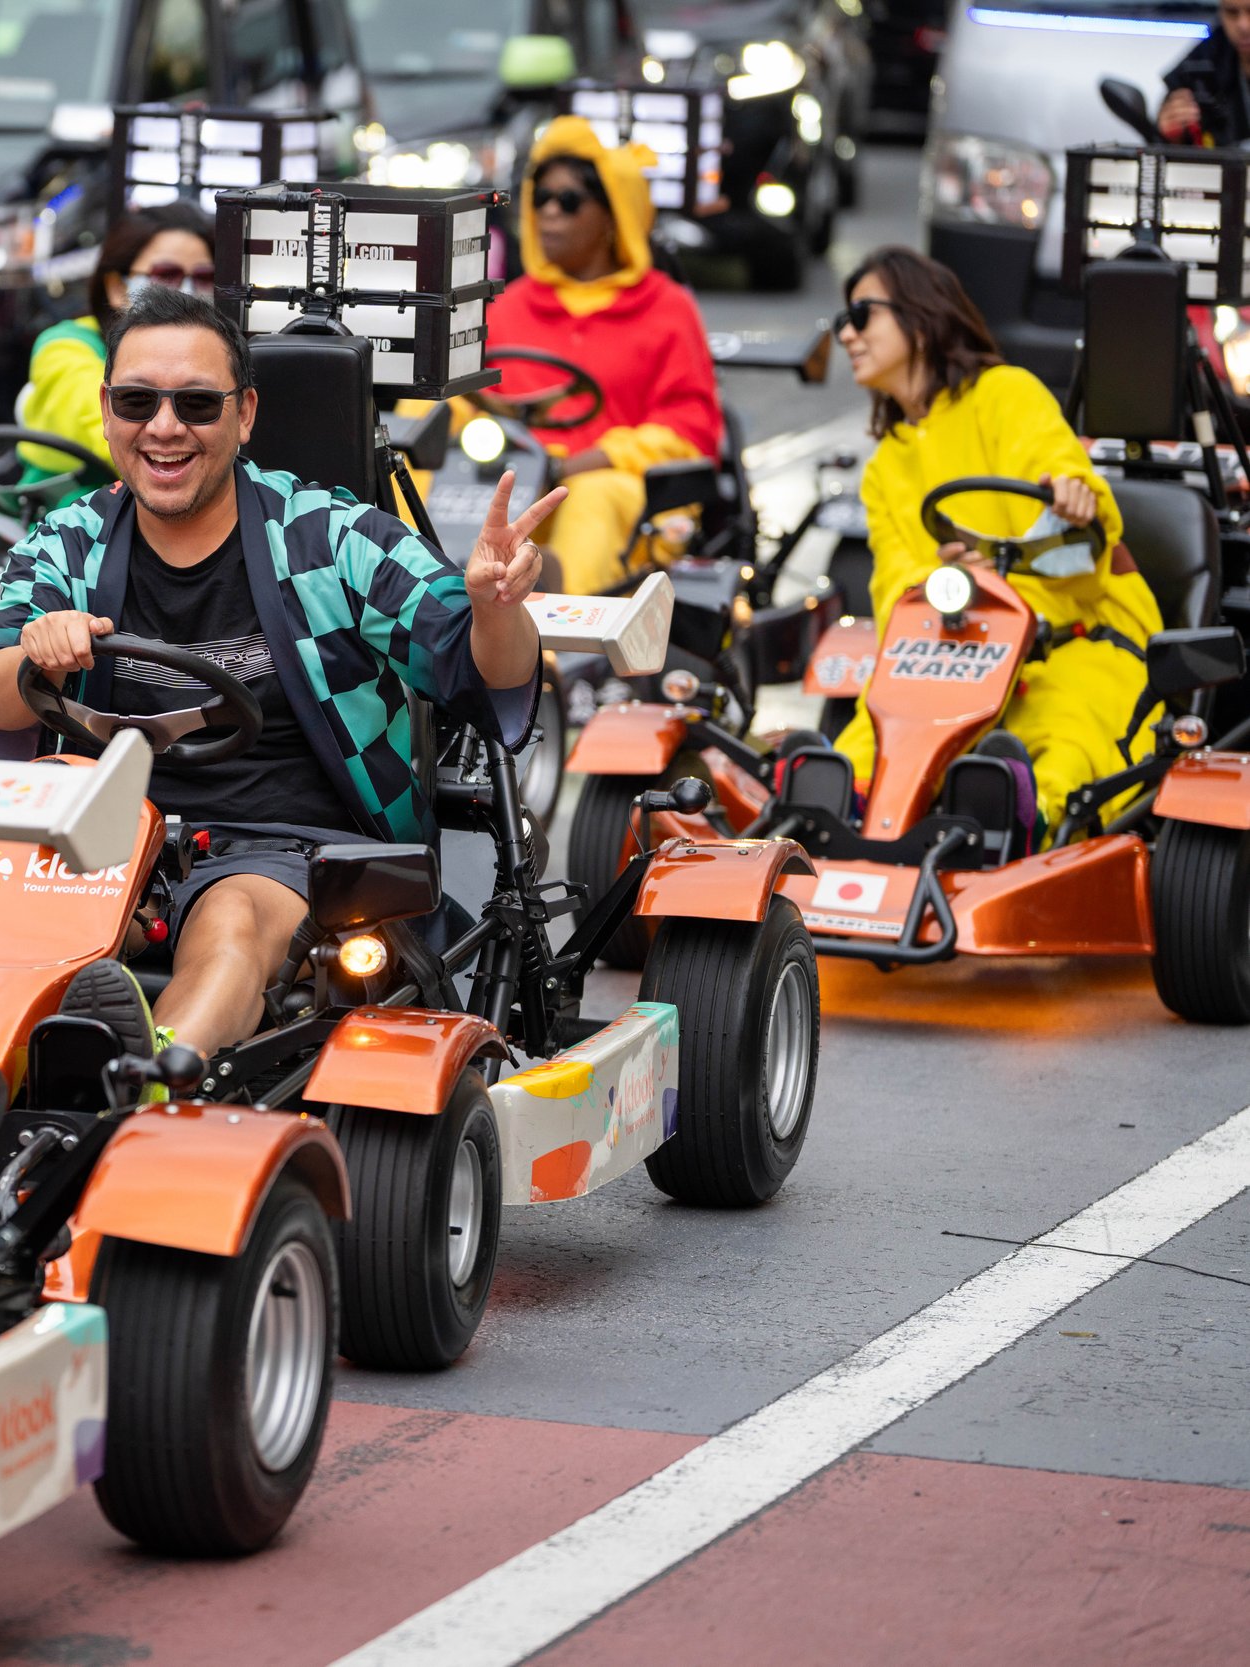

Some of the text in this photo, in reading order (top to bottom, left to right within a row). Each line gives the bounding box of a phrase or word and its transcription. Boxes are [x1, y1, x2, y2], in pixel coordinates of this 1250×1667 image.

[312, 203, 331, 283] APANKART
[883, 638, 1012, 662] JAPAN
[889, 658, 996, 682] KART
[23, 883, 123, 898] Your world of joy
